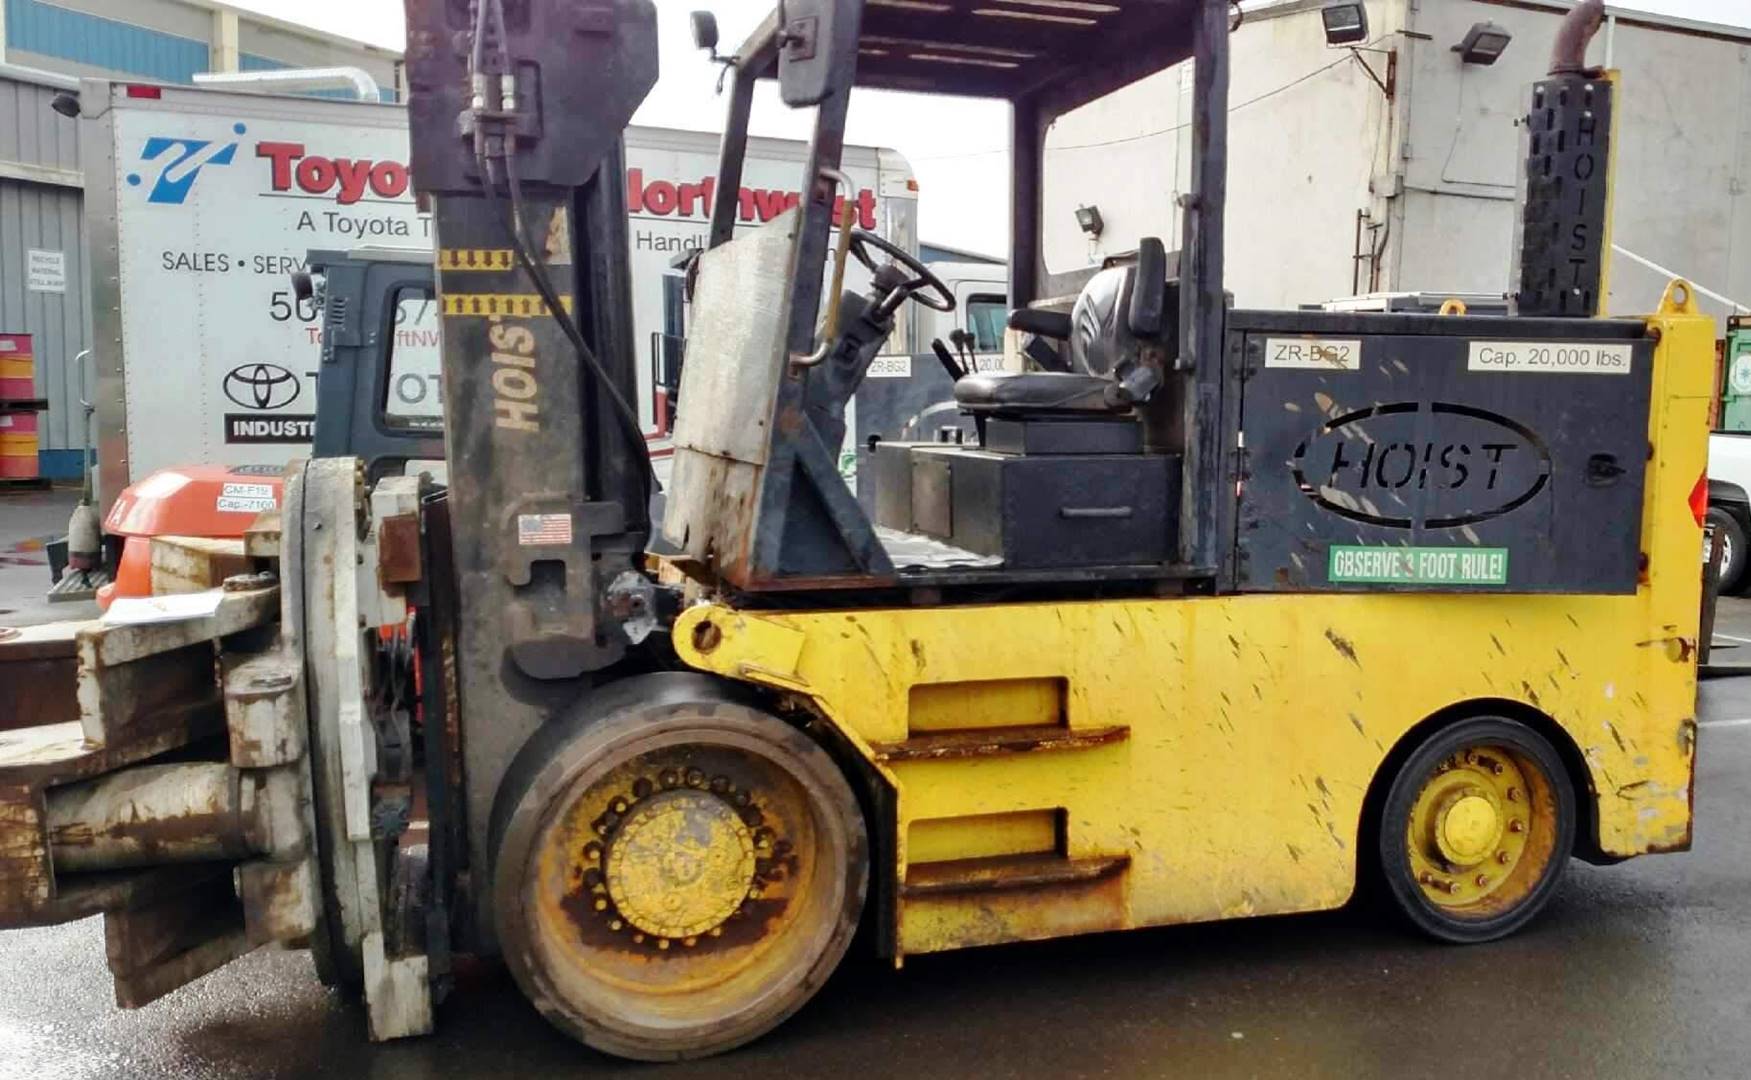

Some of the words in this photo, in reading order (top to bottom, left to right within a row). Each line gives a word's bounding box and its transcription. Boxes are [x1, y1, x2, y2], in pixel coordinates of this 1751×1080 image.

[1569, 117, 1597, 288] HOIST
[296, 210, 316, 232] A
[323, 211, 410, 239] Toyota
[162, 251, 230, 272] SALES
[1274, 344, 1351, 363] ZR-BG2
[1479, 346, 1521, 367] Cap.
[1527, 348, 1590, 367] 20,000
[1596, 350, 1627, 368] lbs.
[489, 315, 540, 432] HOIS
[1327, 442, 1518, 490] HOIST
[1334, 550, 1400, 577] OBSERVE
[1420, 552, 1458, 579] FOOT
[1462, 554, 1503, 580] RULE!
